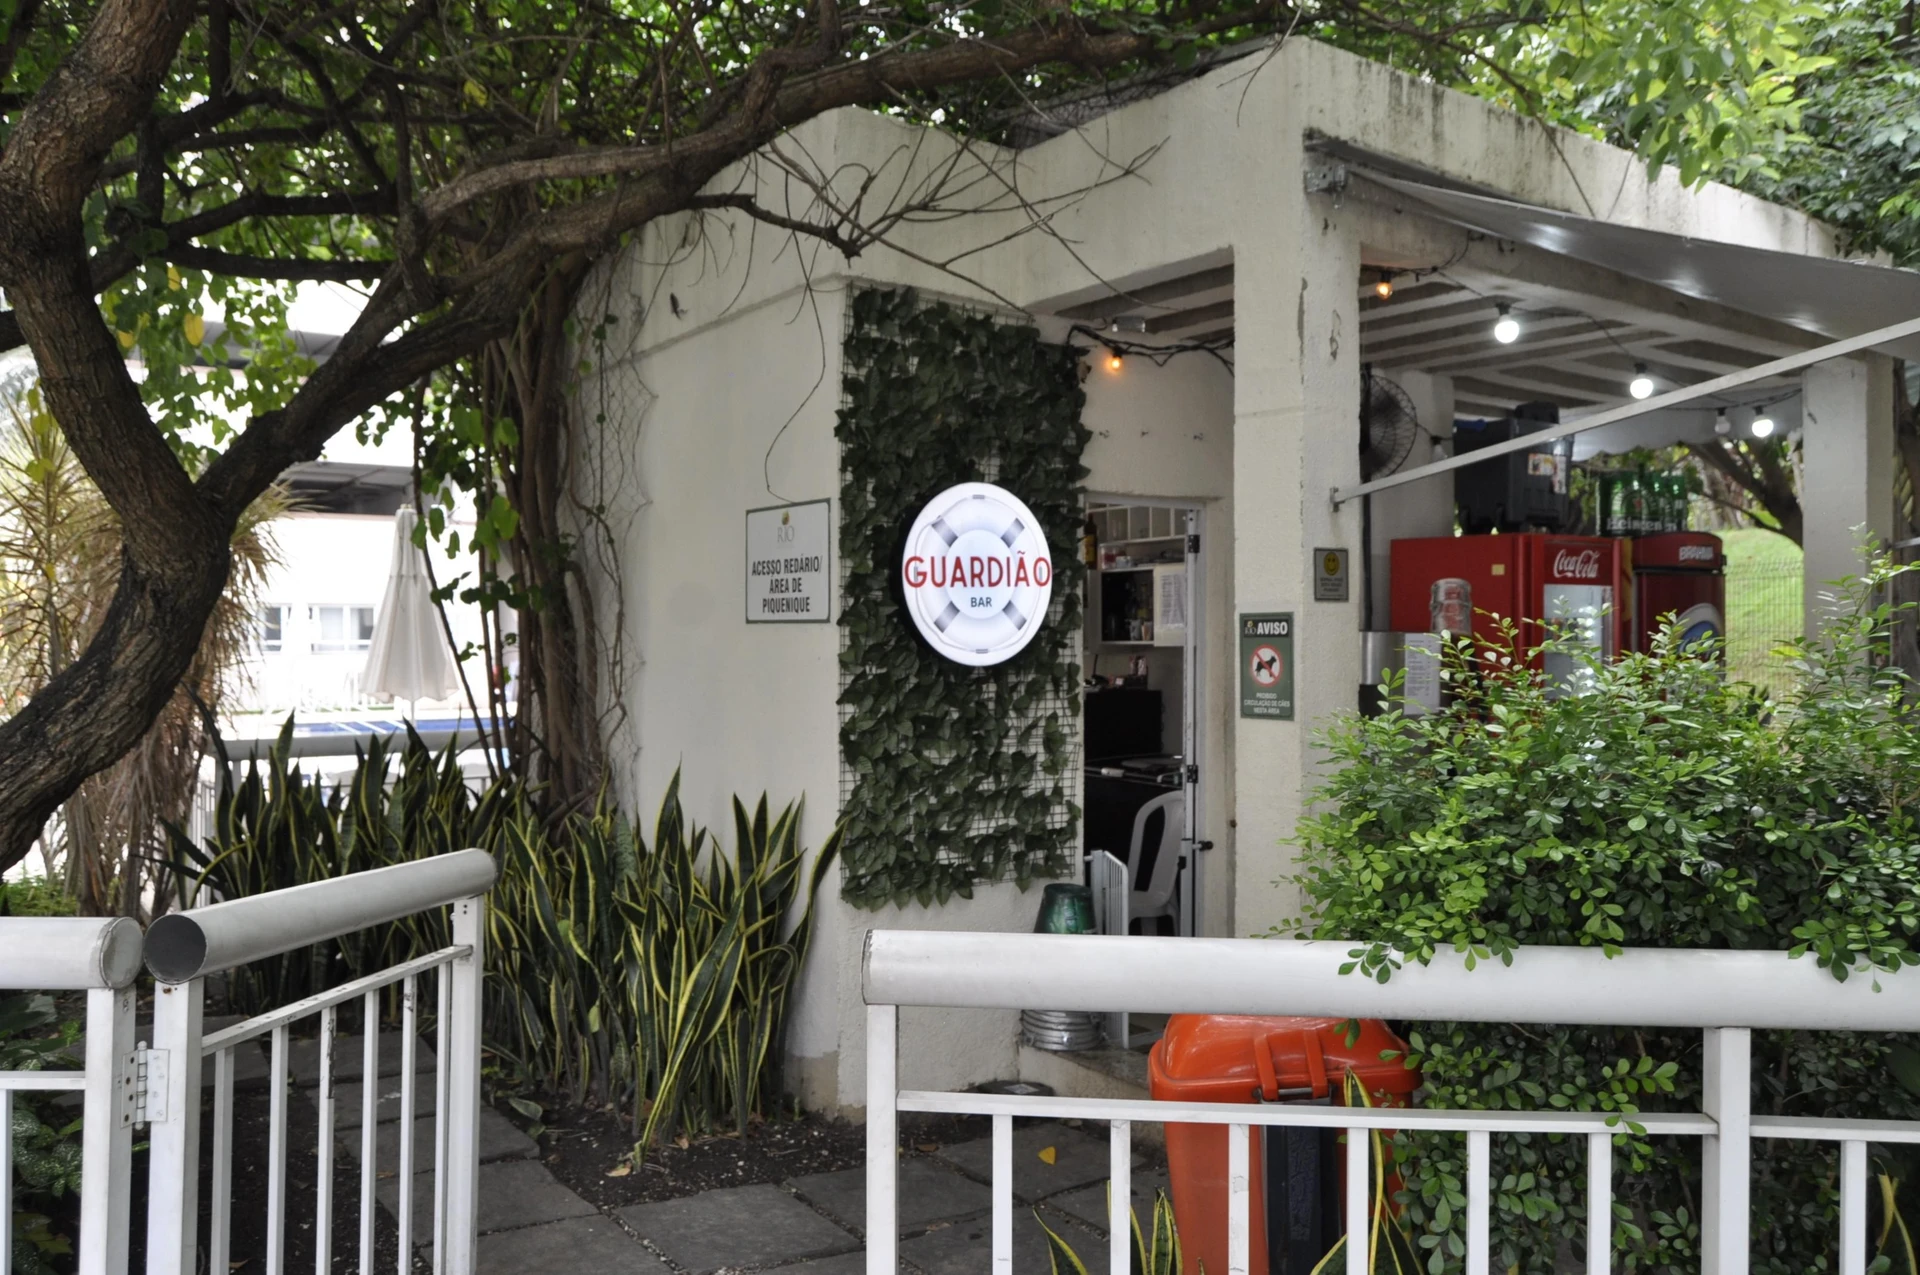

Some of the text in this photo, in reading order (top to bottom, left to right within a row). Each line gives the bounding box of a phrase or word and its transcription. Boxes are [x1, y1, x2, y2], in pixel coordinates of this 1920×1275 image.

[752, 559, 781, 576] ACESSO
[904, 550, 1051, 588] GUARDIÃO
[769, 575, 802, 594] ÁREA DE
[762, 597, 810, 614] PIQUENIQUE
[970, 597, 992, 608] BAR
[1257, 621, 1288, 635] AVISO
